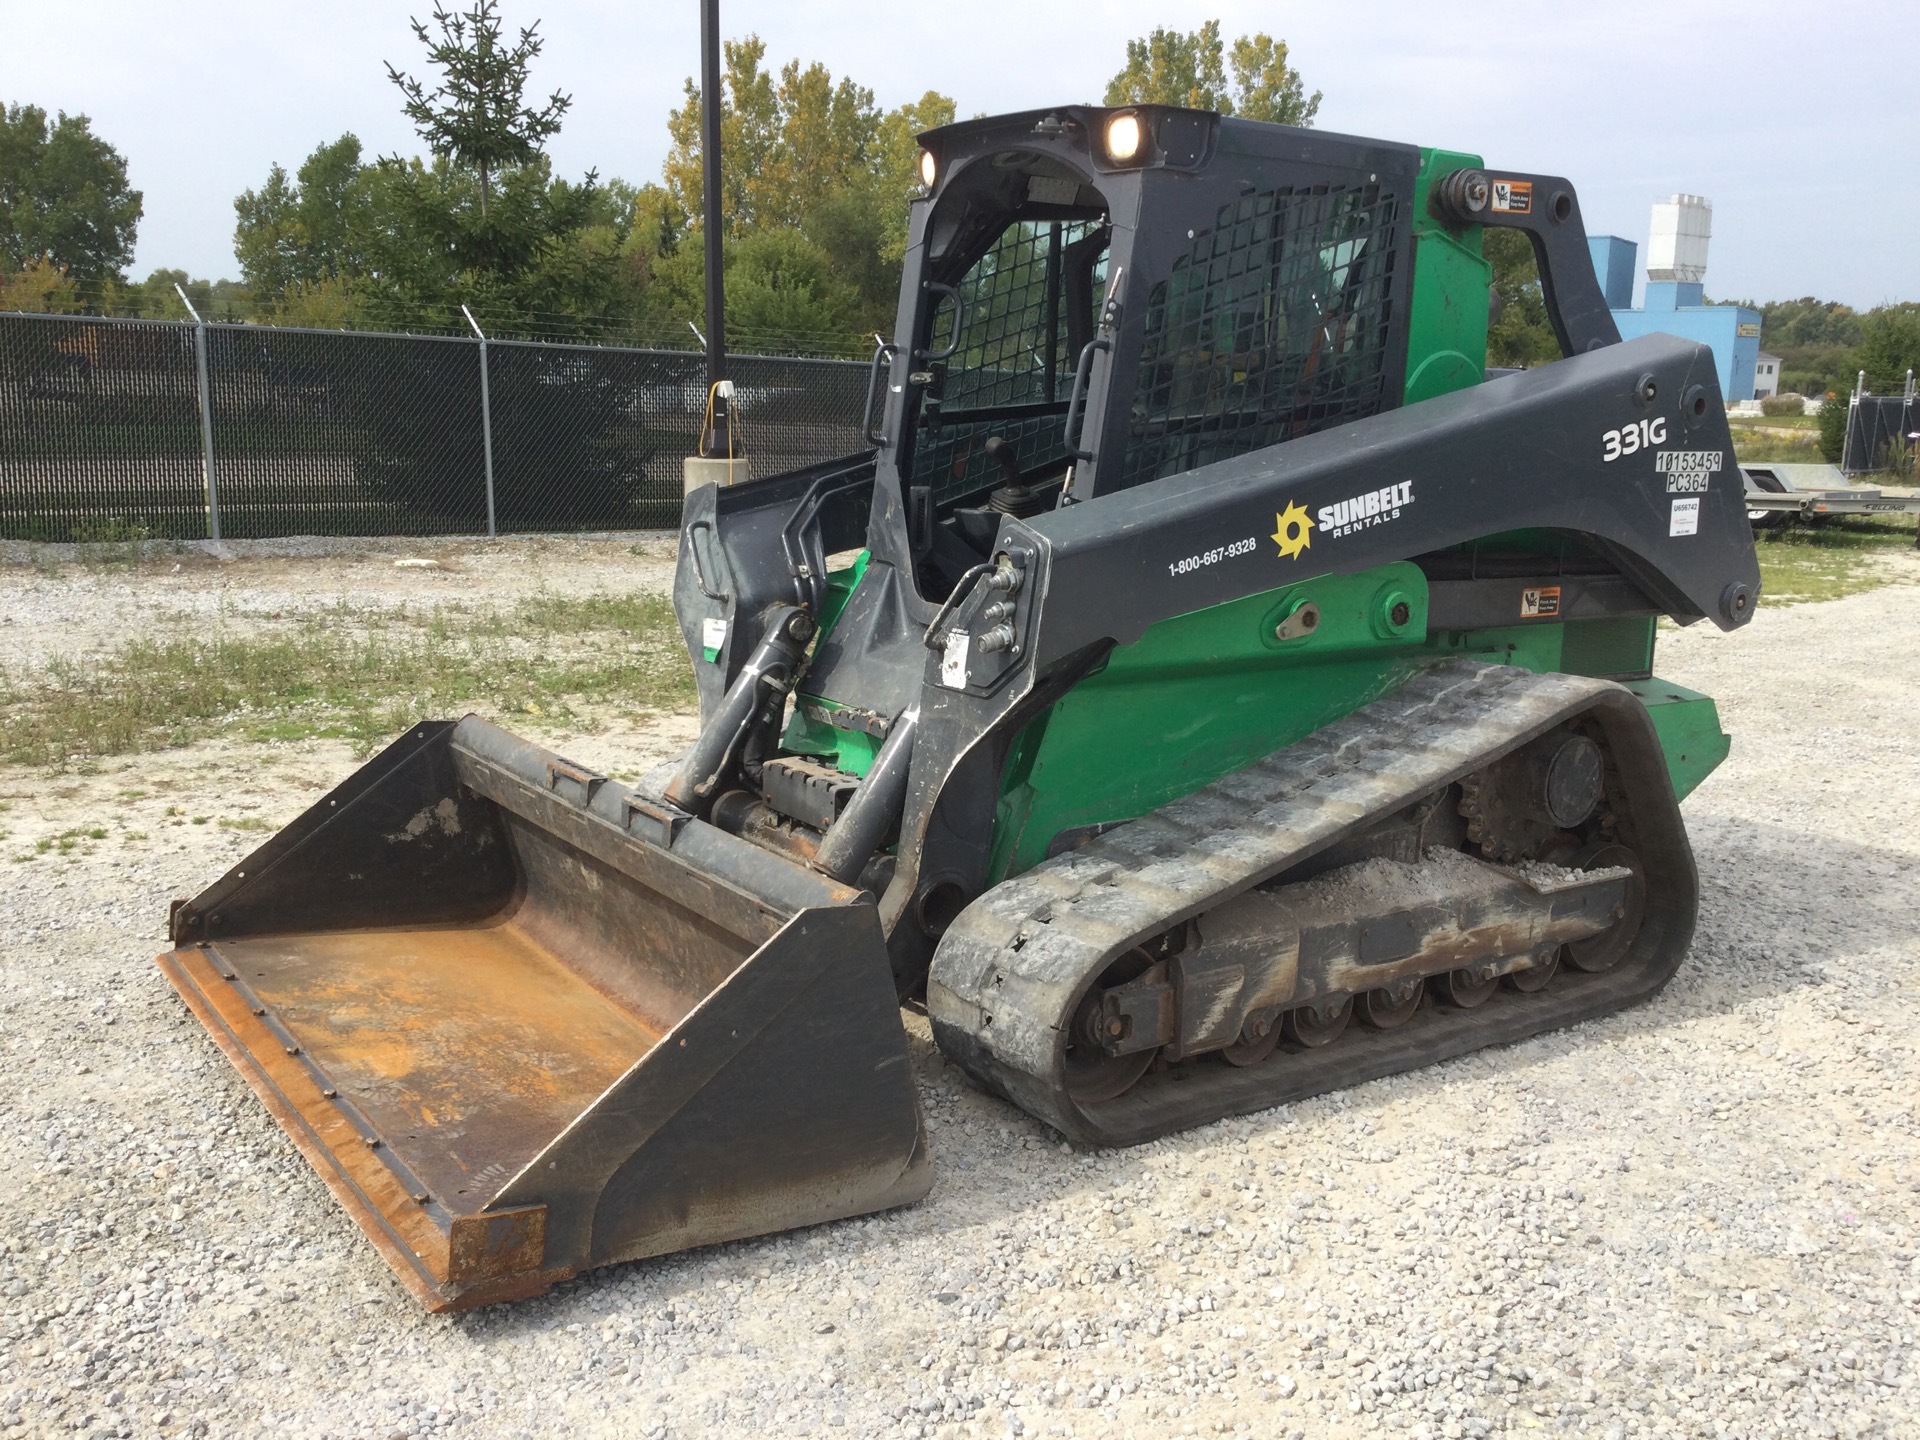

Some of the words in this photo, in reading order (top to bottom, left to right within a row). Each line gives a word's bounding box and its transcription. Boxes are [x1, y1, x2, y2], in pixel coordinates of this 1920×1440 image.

[1602, 417, 1667, 462] 331G
[1658, 452, 1720, 471] 10153459
[1667, 473, 1708, 491] PC364
[1318, 480, 1412, 532] SUNBELT
[1333, 508, 1401, 539] RENTALS
[1168, 537, 1257, 577] 1-800-667-9328
